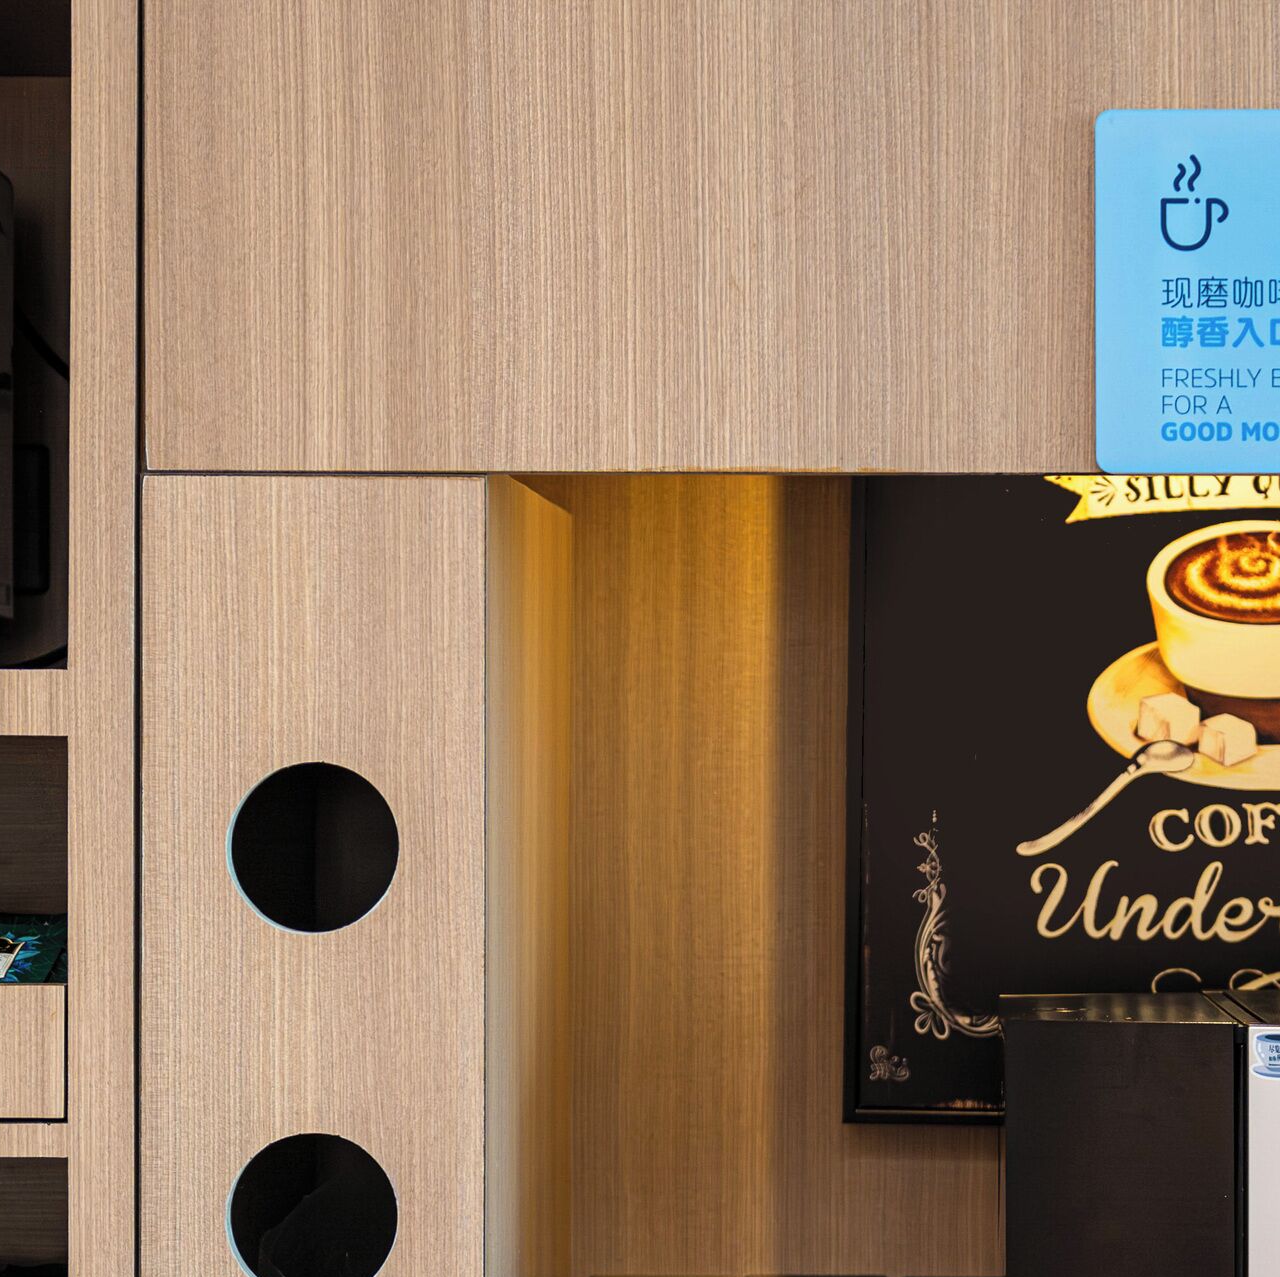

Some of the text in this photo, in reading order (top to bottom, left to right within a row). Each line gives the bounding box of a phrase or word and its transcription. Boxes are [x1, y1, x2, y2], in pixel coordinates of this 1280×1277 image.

[1161, 368, 1261, 389] FRESHLY
[1161, 395, 1233, 415] FOR A
[1161, 422, 1233, 442] GOOD
[1124, 476, 1231, 503] SILLY
